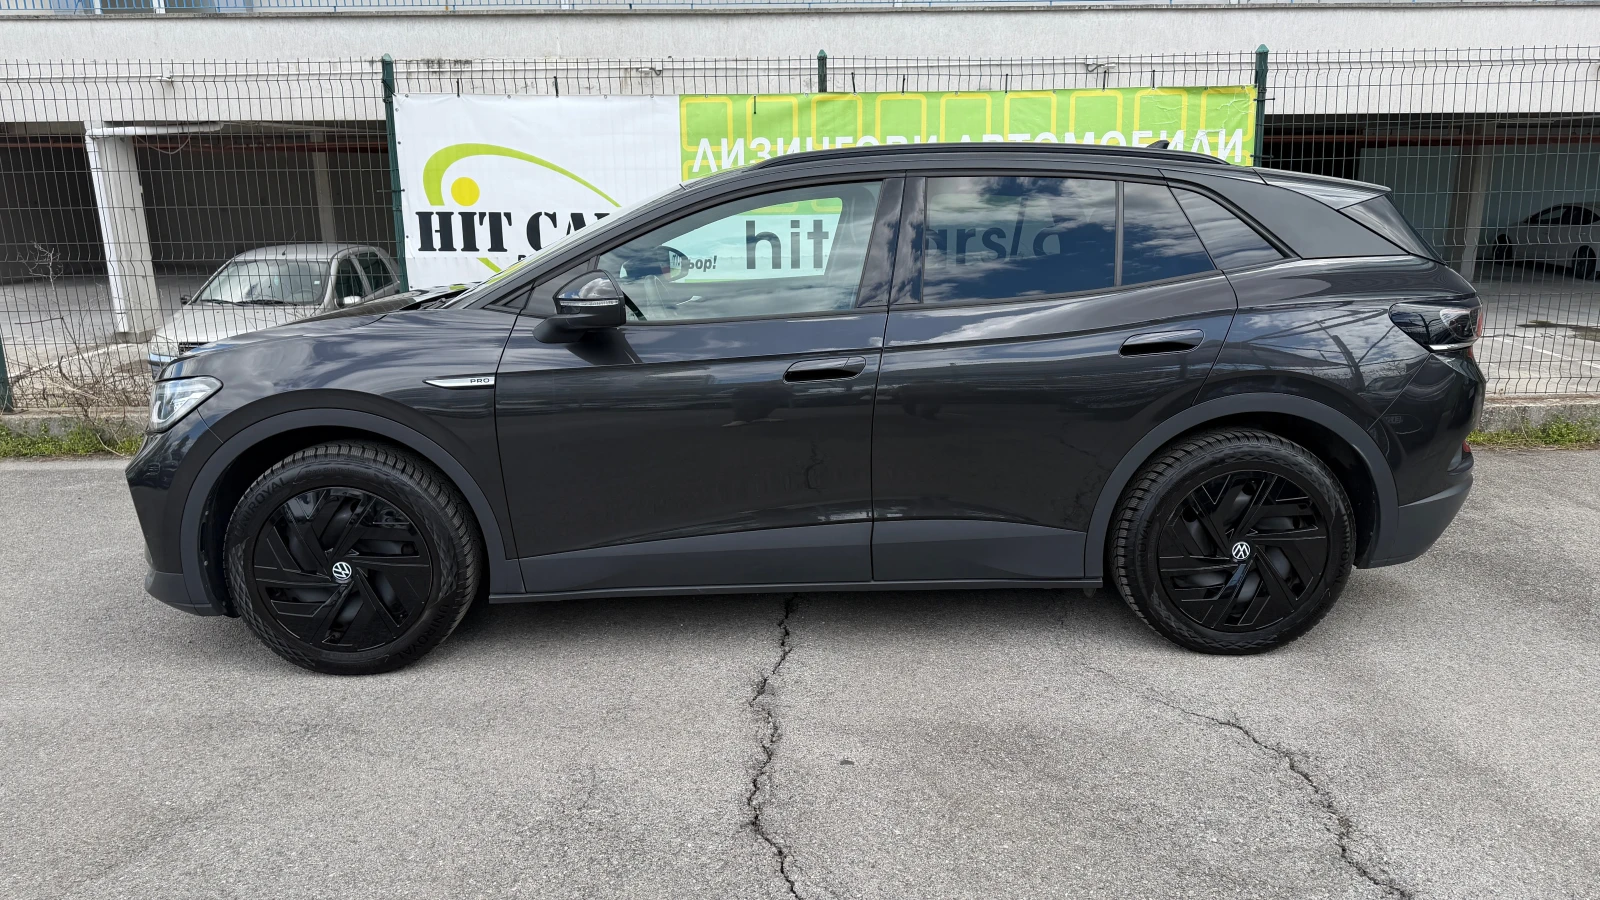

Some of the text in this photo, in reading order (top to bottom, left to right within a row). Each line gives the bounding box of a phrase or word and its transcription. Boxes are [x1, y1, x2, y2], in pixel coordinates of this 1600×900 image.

[415, 211, 610, 252] HIT CA
[745, 219, 829, 270] hit
[234, 476, 289, 538] UNIROYAL
[396, 603, 450, 659] UNIROYAL
